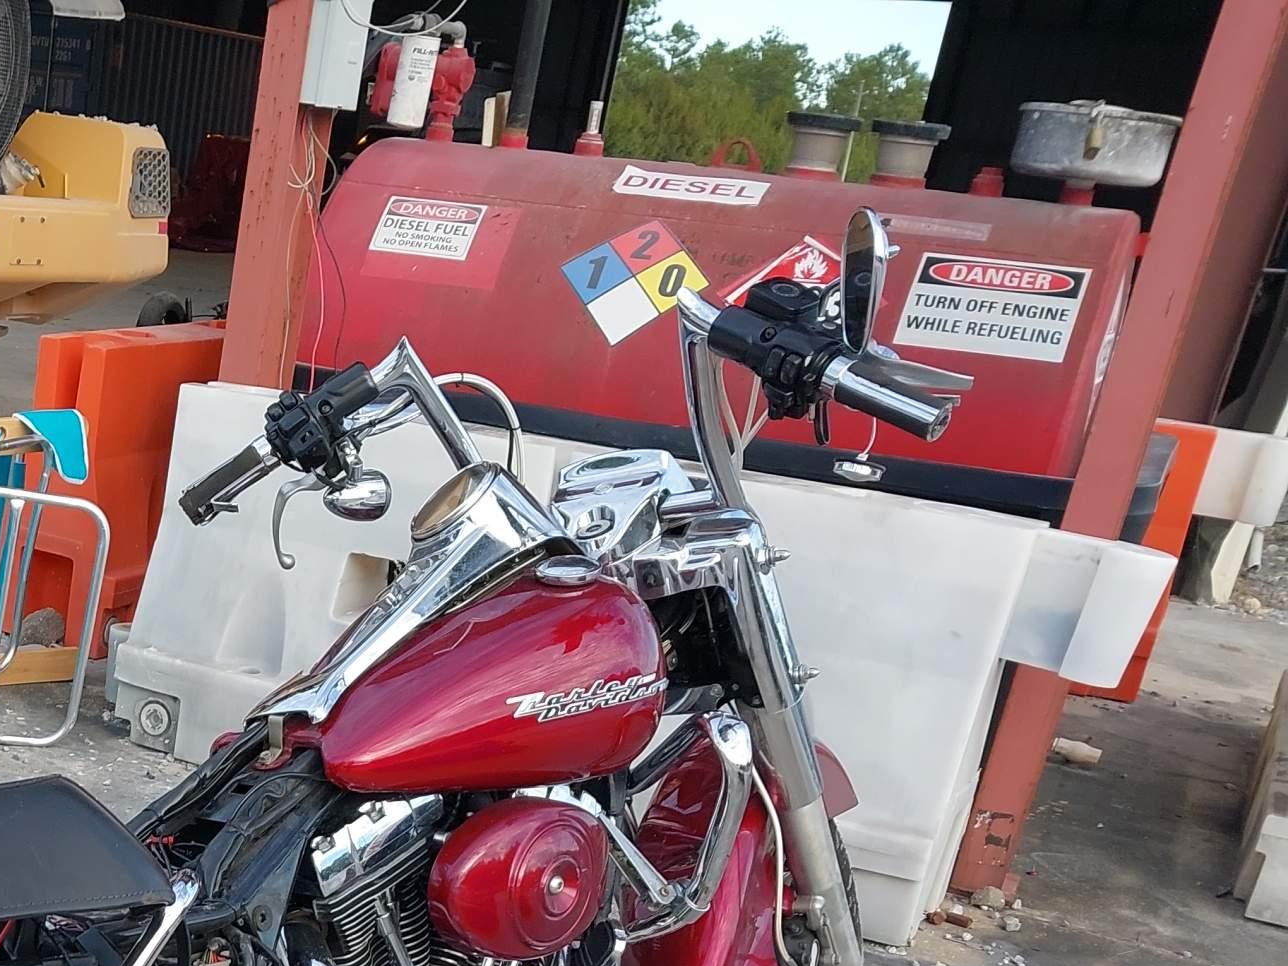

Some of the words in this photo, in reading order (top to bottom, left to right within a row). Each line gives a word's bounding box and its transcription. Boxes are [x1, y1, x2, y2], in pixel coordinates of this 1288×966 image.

[622, 175, 755, 199] DIESEL
[399, 202, 468, 220] DANGER
[384, 217, 430, 233] DIESEL
[434, 223, 469, 237] FUEL
[395, 231, 409, 239] NO
[410, 232, 453, 244] SMOKING
[383, 238, 397, 246] NO
[398, 239, 423, 249] OPEN
[423, 242, 459, 253] FLAMES
[630, 230, 660, 260] 2
[586, 255, 609, 290] 1
[657, 263, 687, 298] 0
[948, 264, 1053, 291] DANGER
[914, 293, 962, 311] TURN
[965, 298, 998, 314] OFF
[1001, 302, 1070, 323] ENGINE
[906, 314, 963, 334] WHILE
[965, 321, 1063, 346] REFUELING
